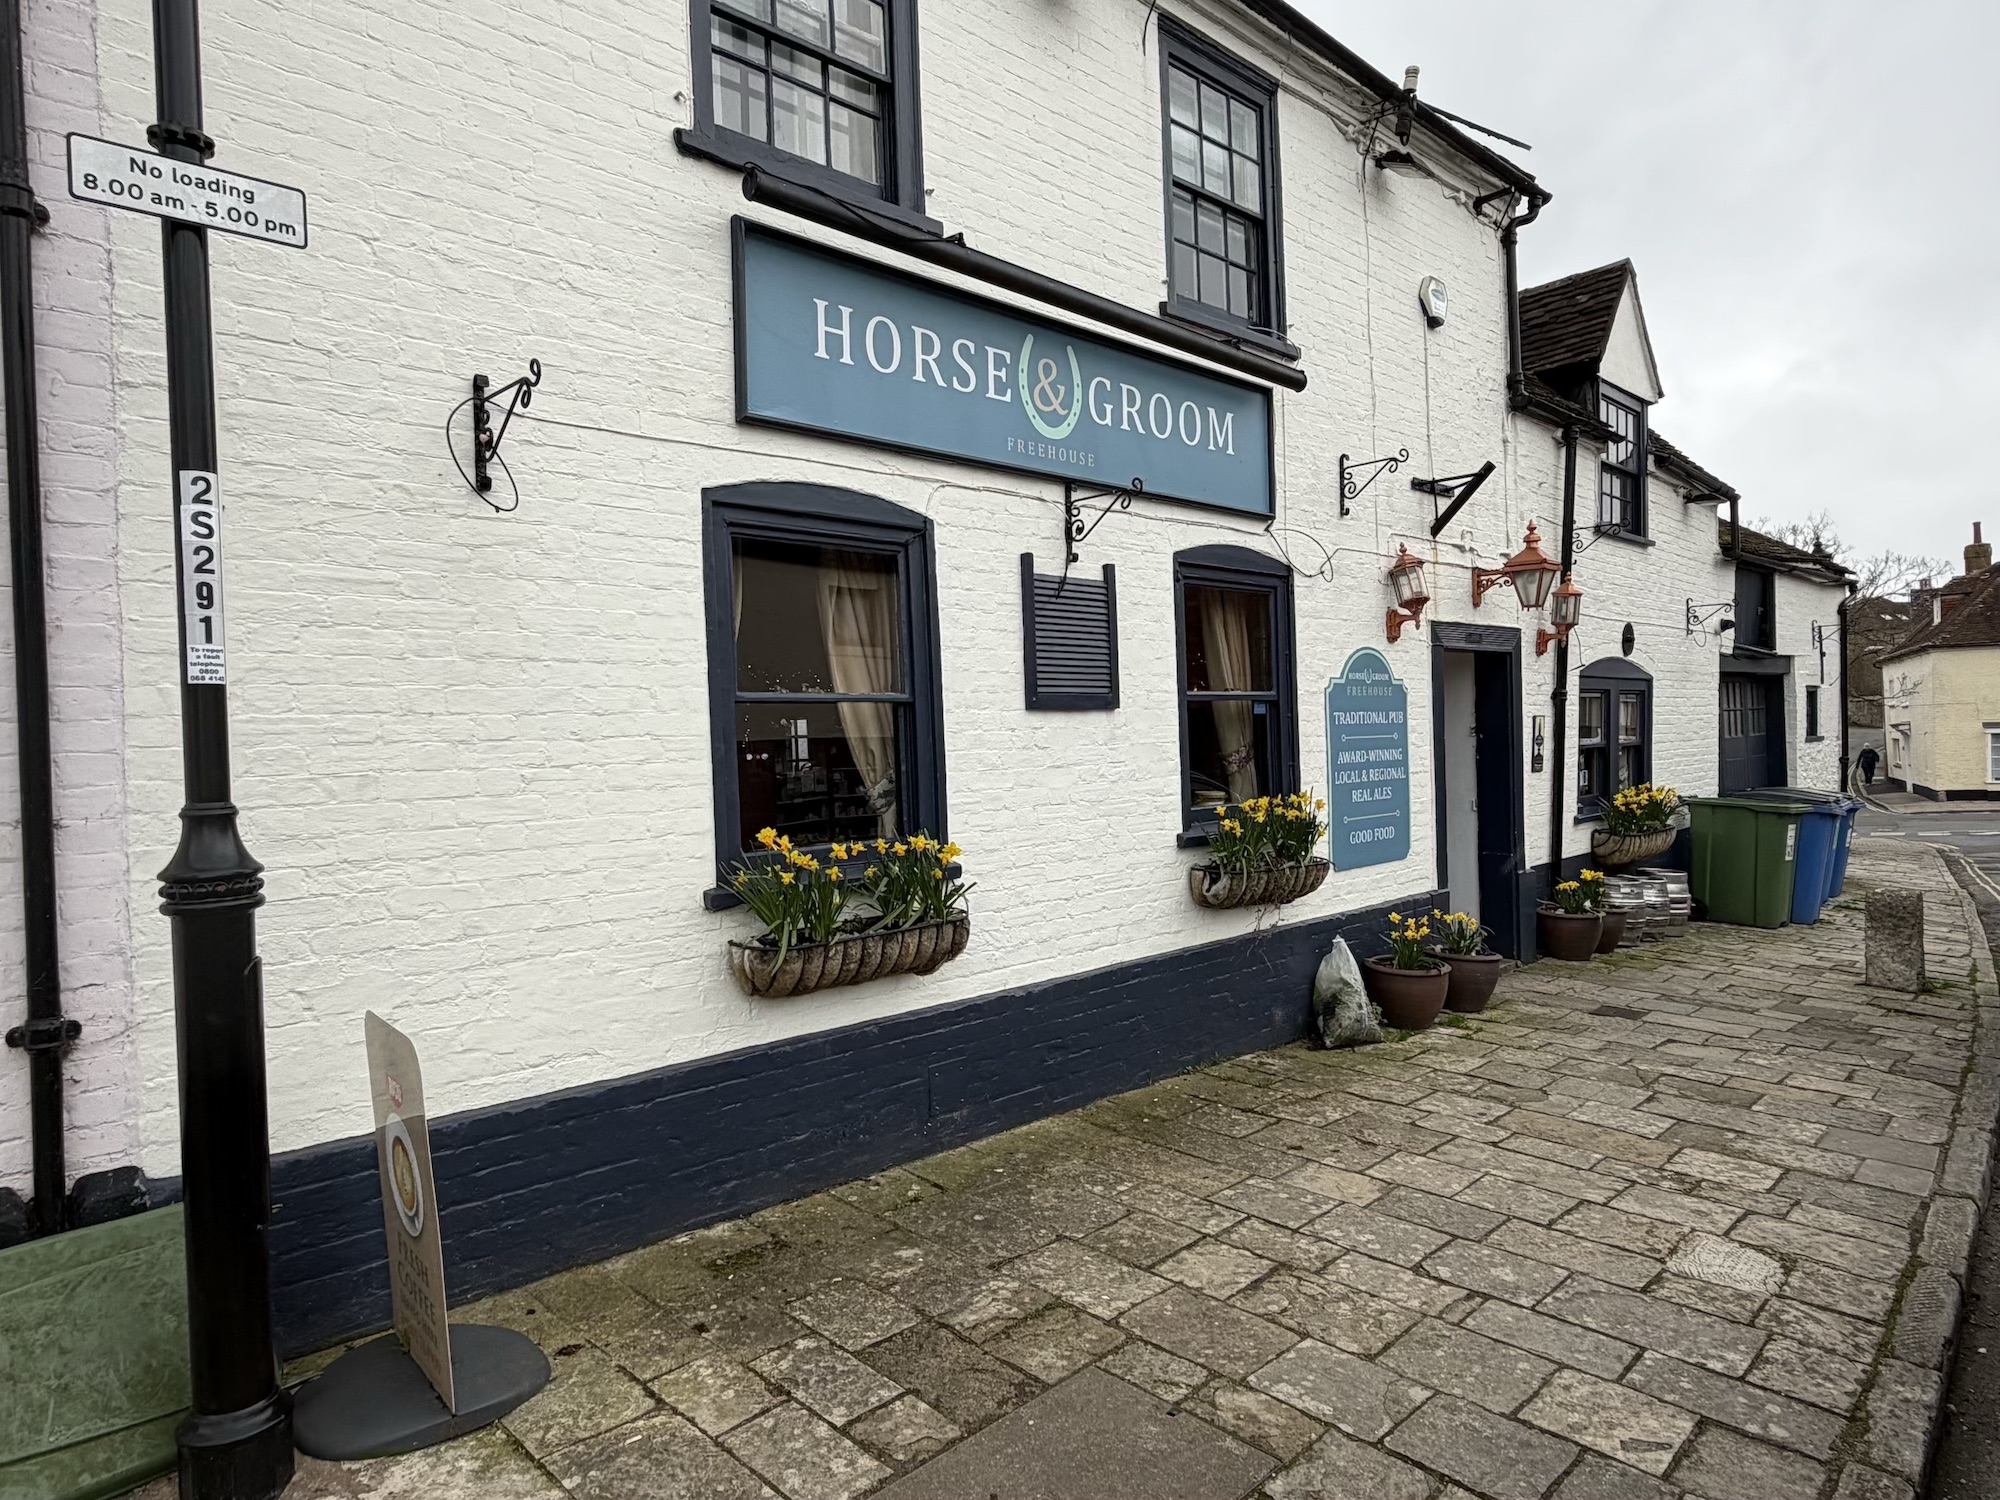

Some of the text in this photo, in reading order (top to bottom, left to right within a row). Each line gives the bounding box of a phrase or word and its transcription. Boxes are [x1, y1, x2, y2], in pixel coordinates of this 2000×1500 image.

[129, 156, 256, 205] No loading
[83, 172, 143, 201] 8.00
[150, 191, 185, 211] am
[204, 202, 259, 228] 5.00
[264, 217, 296, 237] pm
[812, 297, 1235, 456] HORSE & GROOM
[1007, 437, 1096, 468] FREEHOUSE
[1348, 672, 1365, 680] HORSE
[1346, 686, 1393, 697] FREEHOUSE
[1333, 711, 1404, 725] TRADITIONAL PUB
[1337, 748, 1402, 764] AWARD-WINNING
[1335, 767, 1406, 785] LOCAL & REGIONAL
[1352, 787, 1392, 802] REAL ALES
[1350, 826, 1395, 845] GOOD FOOD
[397, 1260, 436, 1326] COFFEE
